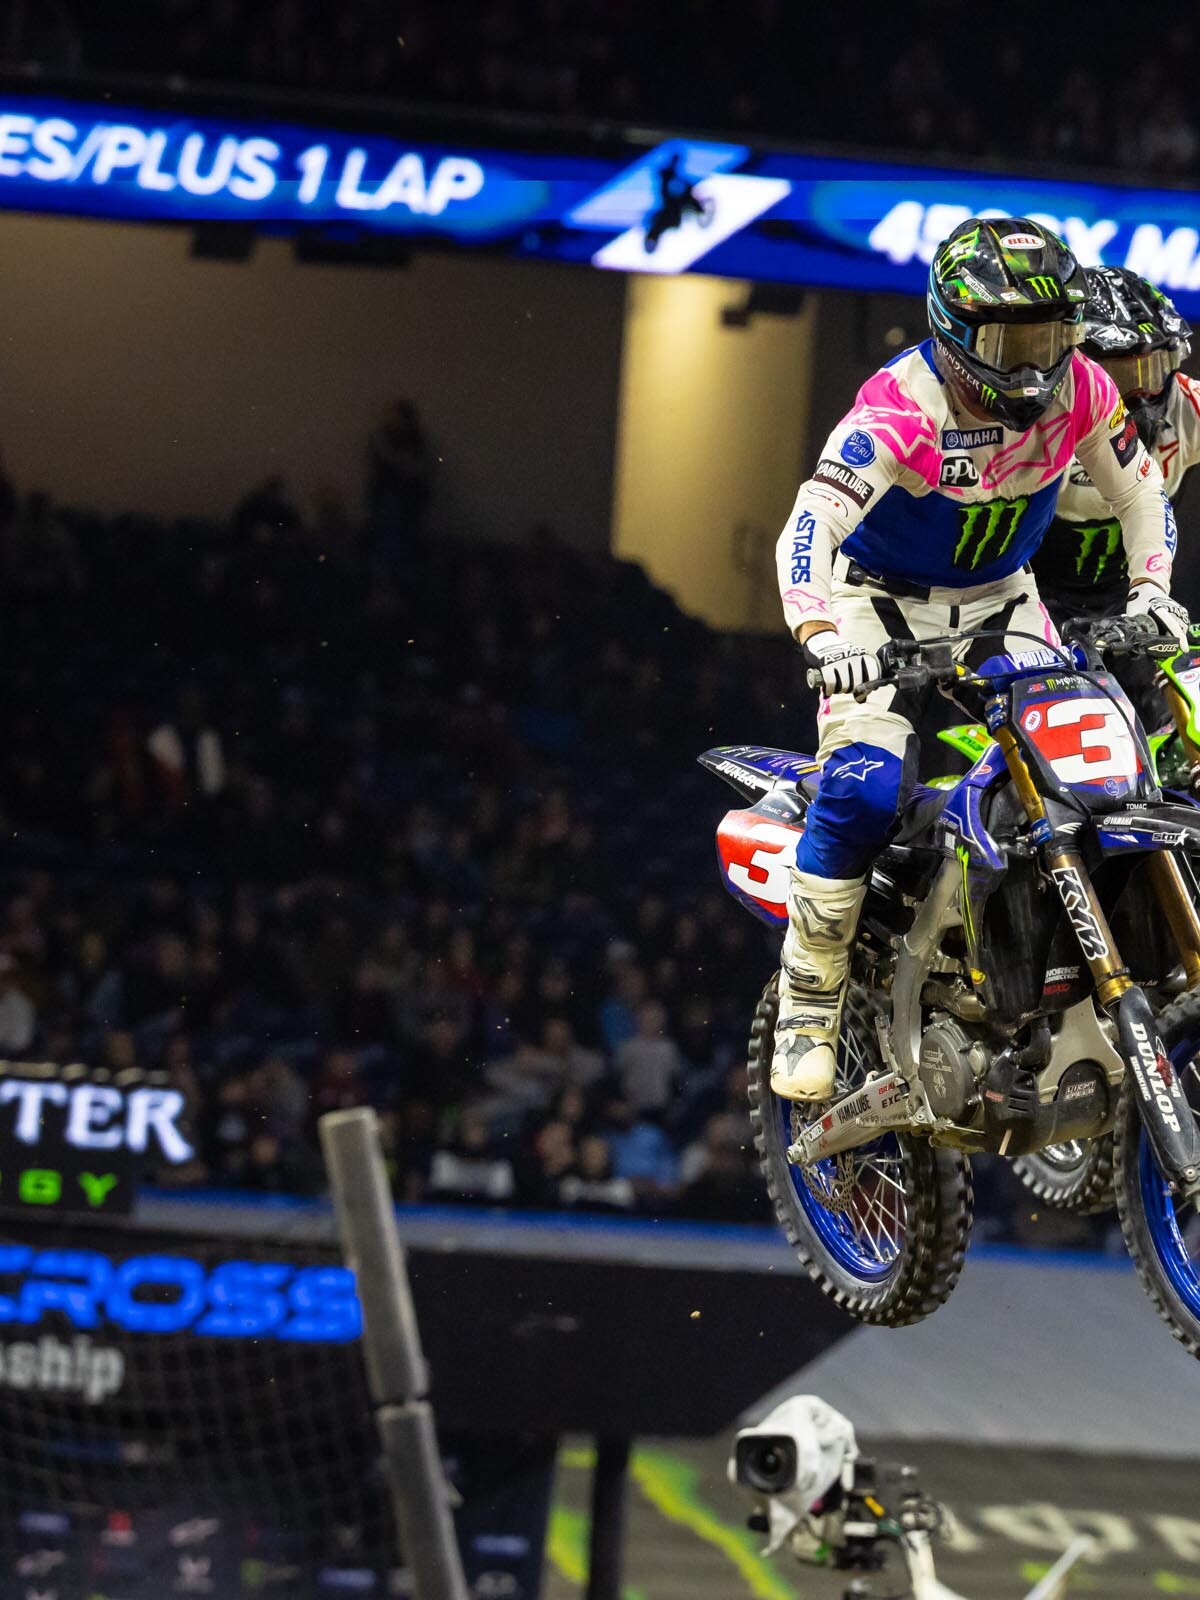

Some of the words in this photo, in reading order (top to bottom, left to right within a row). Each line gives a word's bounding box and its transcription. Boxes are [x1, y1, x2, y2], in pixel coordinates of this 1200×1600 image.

[0, 114, 280, 201] ES/PLUS
[298, 146, 329, 203] 1
[336, 149, 484, 215] LAP
[869, 201, 1118, 268] 45X
[1007, 237, 1039, 245] BELL
[959, 429, 999, 447] MAHA
[816, 462, 871, 500] YAMALUBE
[791, 510, 816, 585] ASTARS
[824, 646, 868, 664] ASTAR
[715, 760, 757, 790] DUNLOP
[1046, 698, 1137, 784] 3
[727, 822, 804, 905] 3
[1053, 866, 1109, 961] KYB
[836, 1094, 872, 1124] YAMALUBE
[1129, 1022, 1181, 1132] DUNLOP
[0, 1334, 125, 1403] ship
